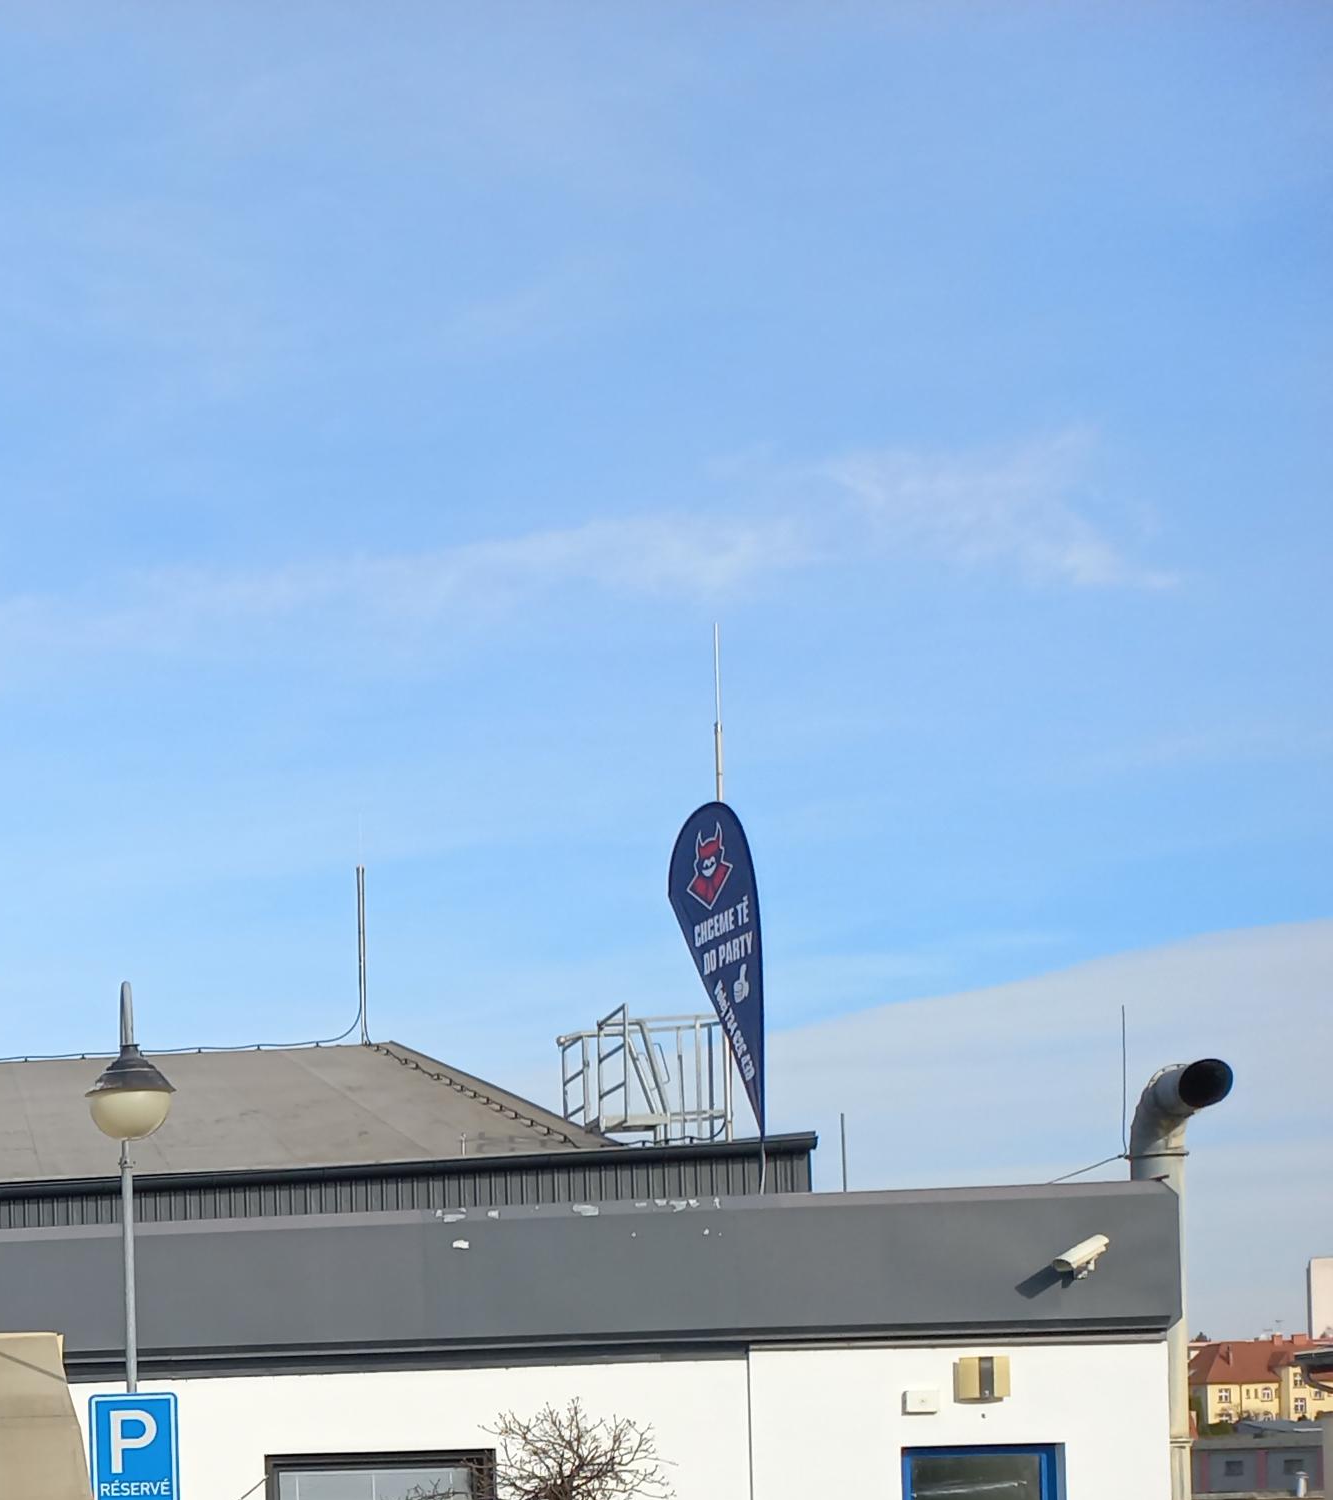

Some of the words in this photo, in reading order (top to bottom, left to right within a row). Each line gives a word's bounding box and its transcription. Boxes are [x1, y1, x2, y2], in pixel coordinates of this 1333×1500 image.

[694, 907, 735, 947] CHCEME
[736, 896, 749, 927] TĚ
[703, 948, 718, 976] DO
[718, 931, 753, 969] PARTY
[109, 1409, 158, 1475] P
[100, 1478, 171, 1497] RÉSERVÉ
